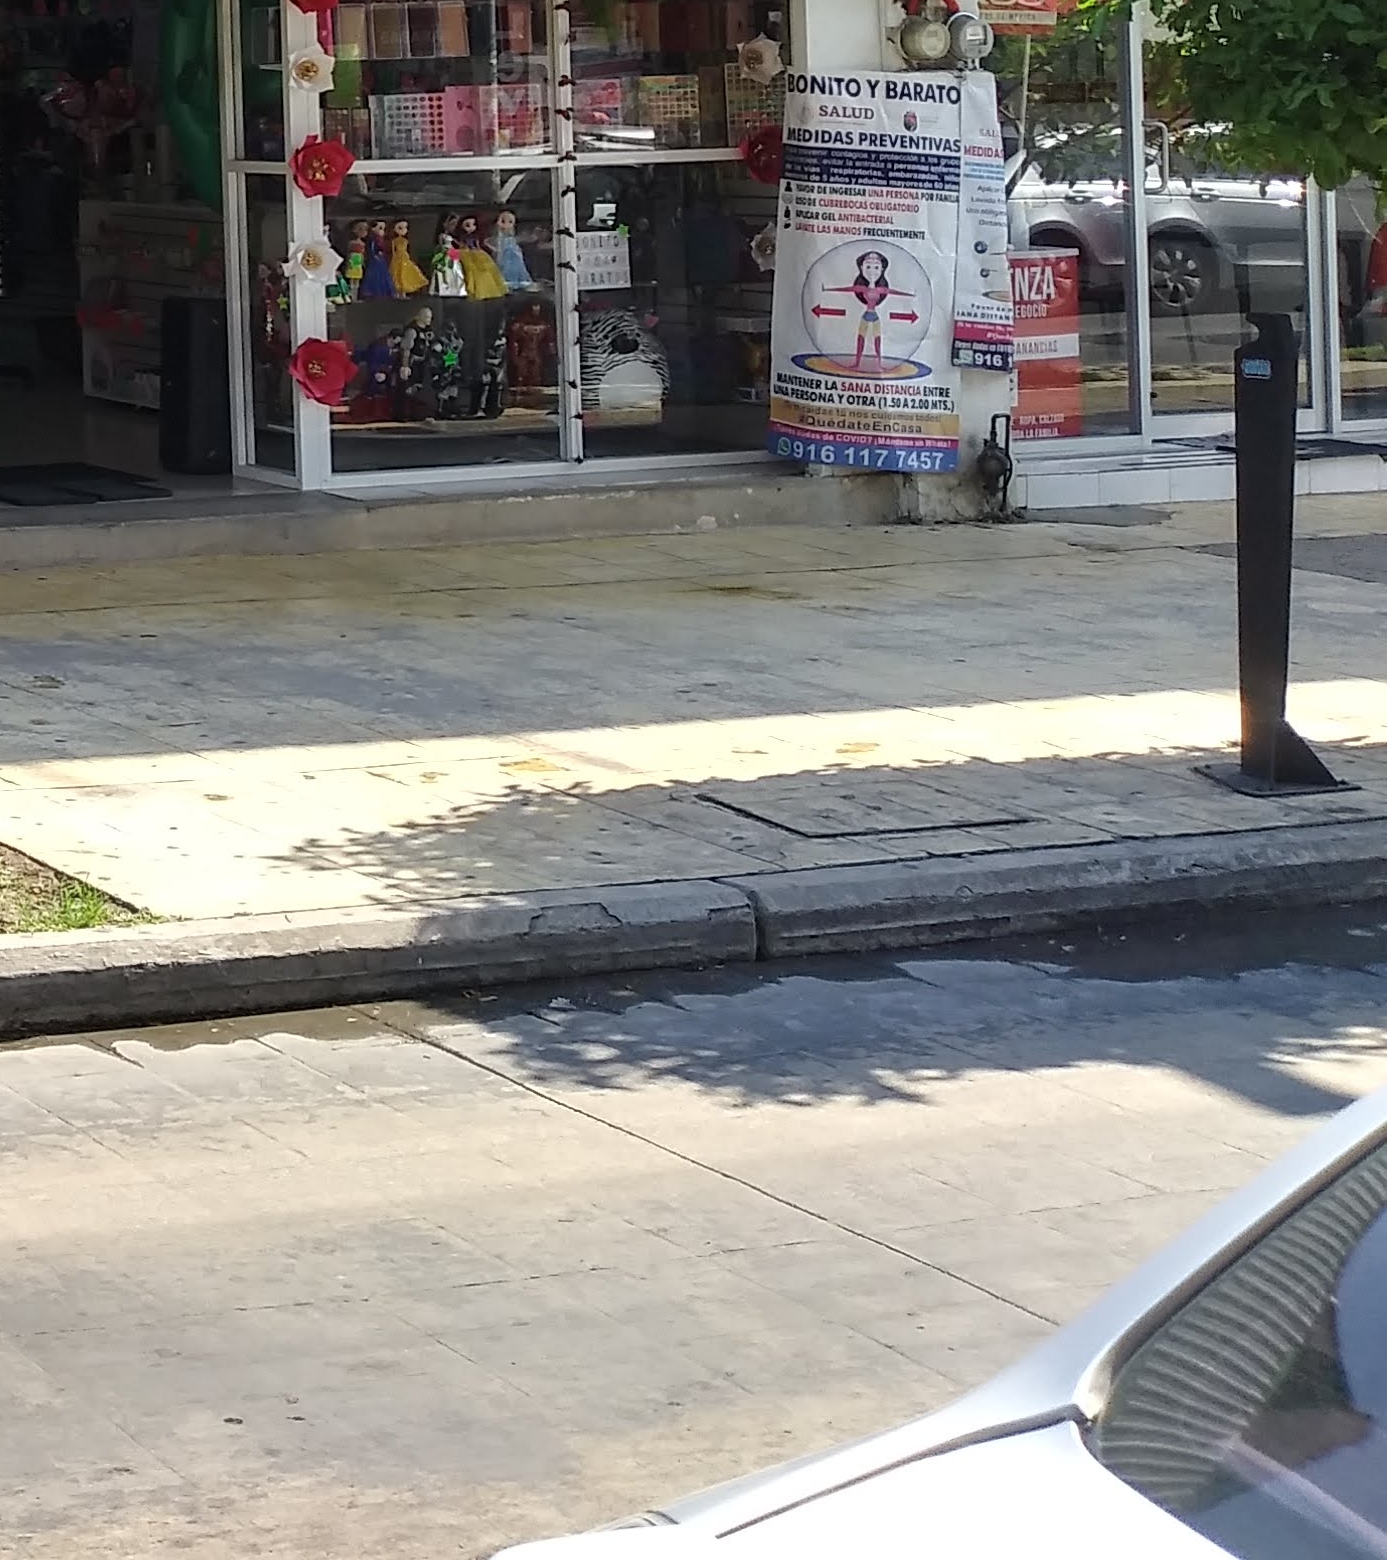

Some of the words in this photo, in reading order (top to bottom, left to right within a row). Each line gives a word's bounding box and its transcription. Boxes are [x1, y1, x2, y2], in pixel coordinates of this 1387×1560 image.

[787, 73, 861, 98] BONITO
[866, 80, 880, 99] Y
[885, 81, 960, 105] BARATO
[819, 105, 875, 120] SALUD
[787, 127, 853, 145] MEDIDAS
[859, 132, 961, 153] PREVENTIVAS
[831, 151, 868, 159] contagios
[964, 145, 1004, 158] MEDIDAS
[810, 173, 820, 181] de
[829, 174, 849, 183] años
[858, 176, 887, 186] adultos
[889, 179, 921, 188] mayores
[817, 186, 827, 194] DE
[829, 187, 866, 197] INGRESAR
[868, 189, 884, 198] UNA
[886, 190, 919, 200] PERSONA
[921, 193, 934, 201] POR
[806, 197, 816, 206] DE
[818, 198, 868, 210] CUBREBOCAS
[869, 201, 919, 213] OBLIGATORIO
[822, 212, 836, 221] GEL
[838, 213, 894, 224] ANTIBACTERIAL
[817, 224, 831, 233] LAS
[833, 225, 862, 235] MANOS
[863, 227, 926, 240] FRECUENTEMENTE
[1010, 266, 1056, 301] NZA
[974, 352, 1001, 366] 916
[777, 372, 821, 390] MANTENER
[824, 380, 838, 390] LA
[840, 381, 870, 393] SANA
[875, 383, 922, 396] DISTANCIA
[923, 386, 950, 398] ENTRE
[774, 384, 789, 396] UNA
[790, 387, 835, 404] PERSONA
[838, 393, 845, 404] Y
[846, 394, 876, 408] OTRA
[878, 398, 902, 409] (1.50
[903, 399, 909, 409] A
[910, 398, 928, 410] 2.00
[930, 400, 955, 413] MTS.)
[849, 410, 869, 418] nos
[799, 415, 922, 433] #QuédateEnCasa
[822, 432, 834, 440] de
[836, 433, 872, 443] COVID?
[792, 442, 835, 463] 916
[844, 446, 889, 467] 117
[896, 450, 944, 469] 7457
